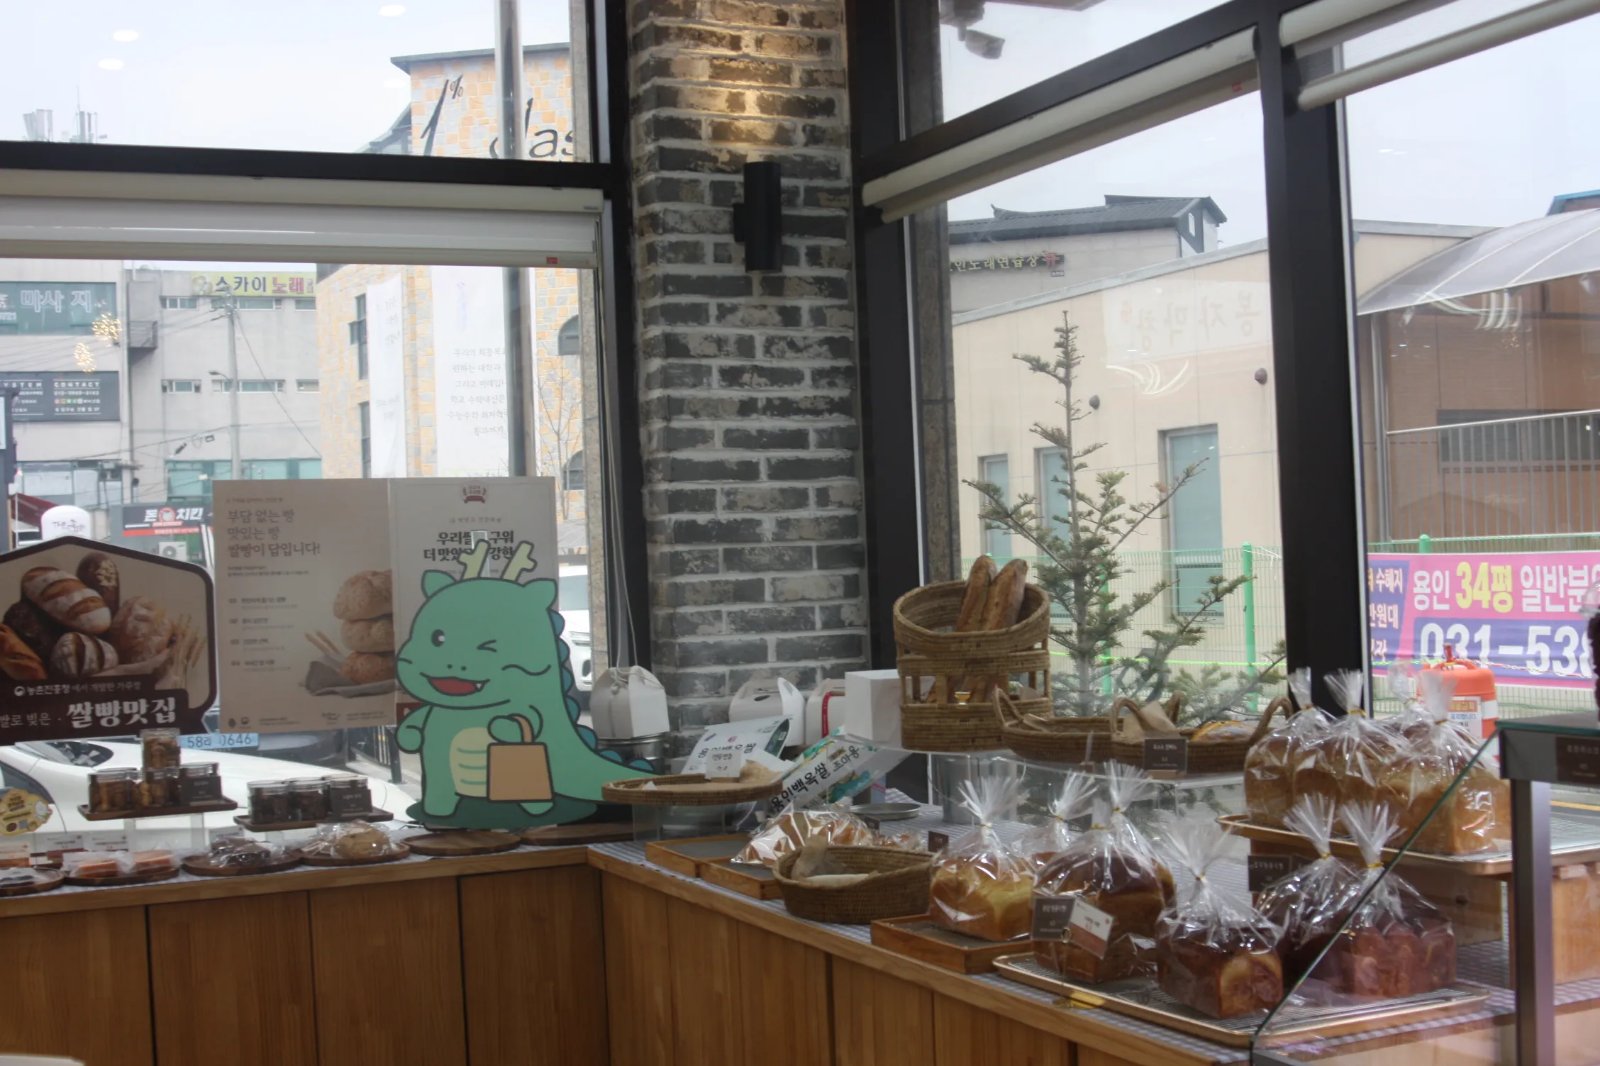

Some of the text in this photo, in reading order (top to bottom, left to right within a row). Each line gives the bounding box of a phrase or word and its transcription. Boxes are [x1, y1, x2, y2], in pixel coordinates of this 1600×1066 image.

[215, 275, 267, 293] 스카이
[176, 507, 204, 520] 치킨
[227, 508, 295, 524] 부담 없는 빵
[227, 526, 280, 541] 맛있는 빵
[268, 541, 321, 557] 답입니다!
[424, 548, 436, 562] 더
[1375, 567, 1403, 594] 수혜지
[1413, 561, 1600, 613] 용인 34평 일반분
[66, 697, 176, 728] 쌀빵맛집
